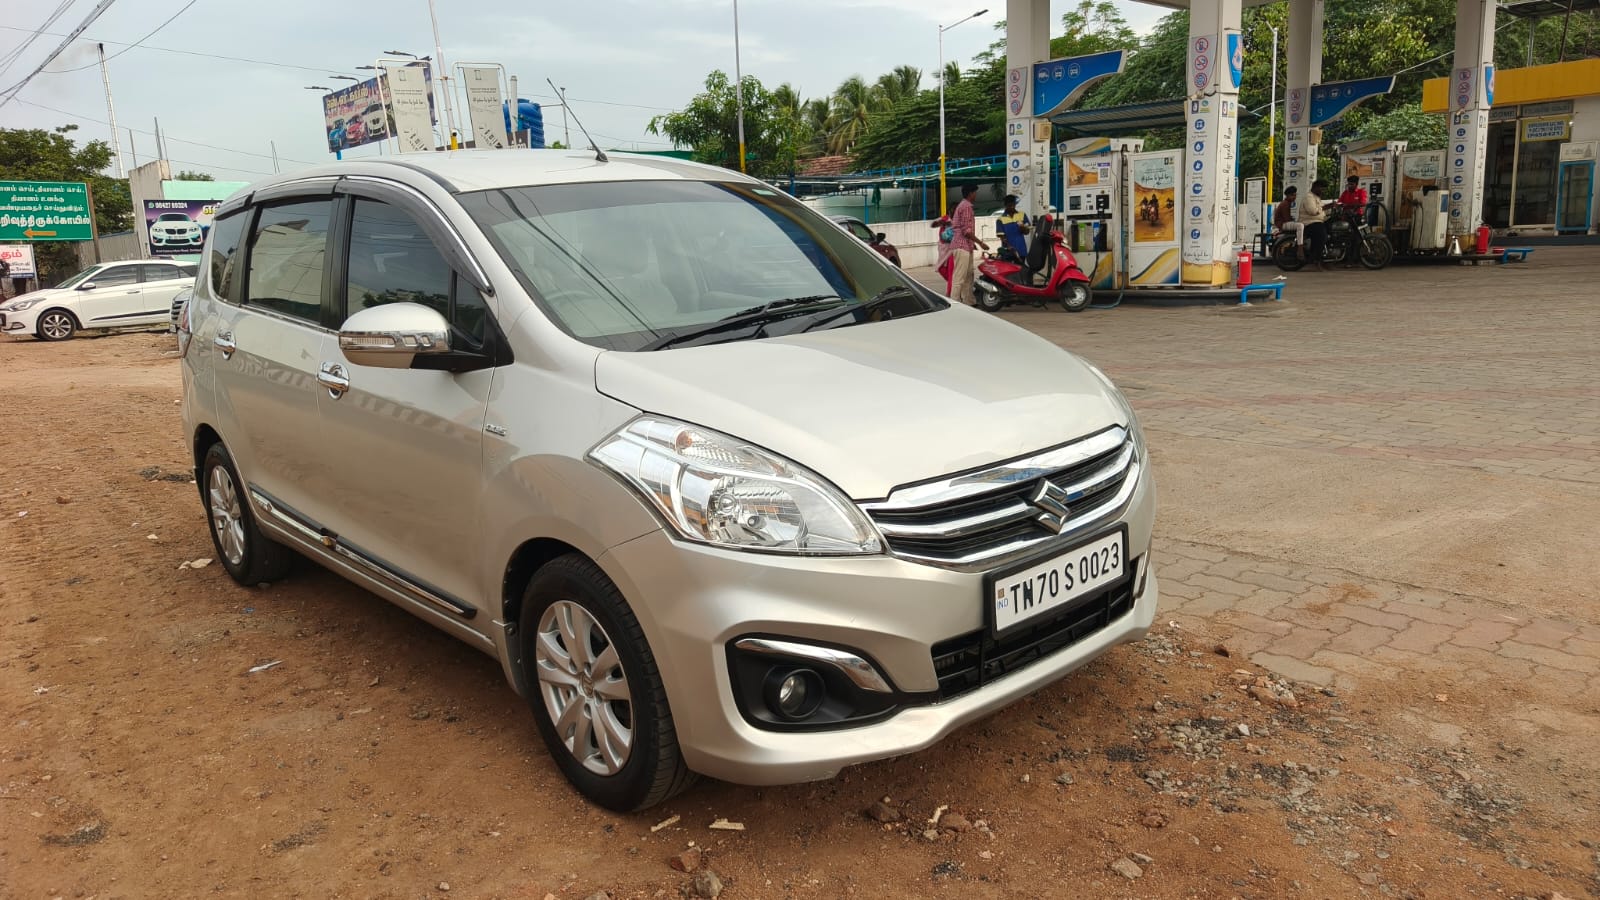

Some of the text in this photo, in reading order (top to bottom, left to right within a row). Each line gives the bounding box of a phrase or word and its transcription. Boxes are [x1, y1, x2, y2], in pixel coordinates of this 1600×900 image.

[0, 214, 90, 227] றிவுத்திருக்கோயில்
[1010, 542, 1120, 614] TN70 S 0023
